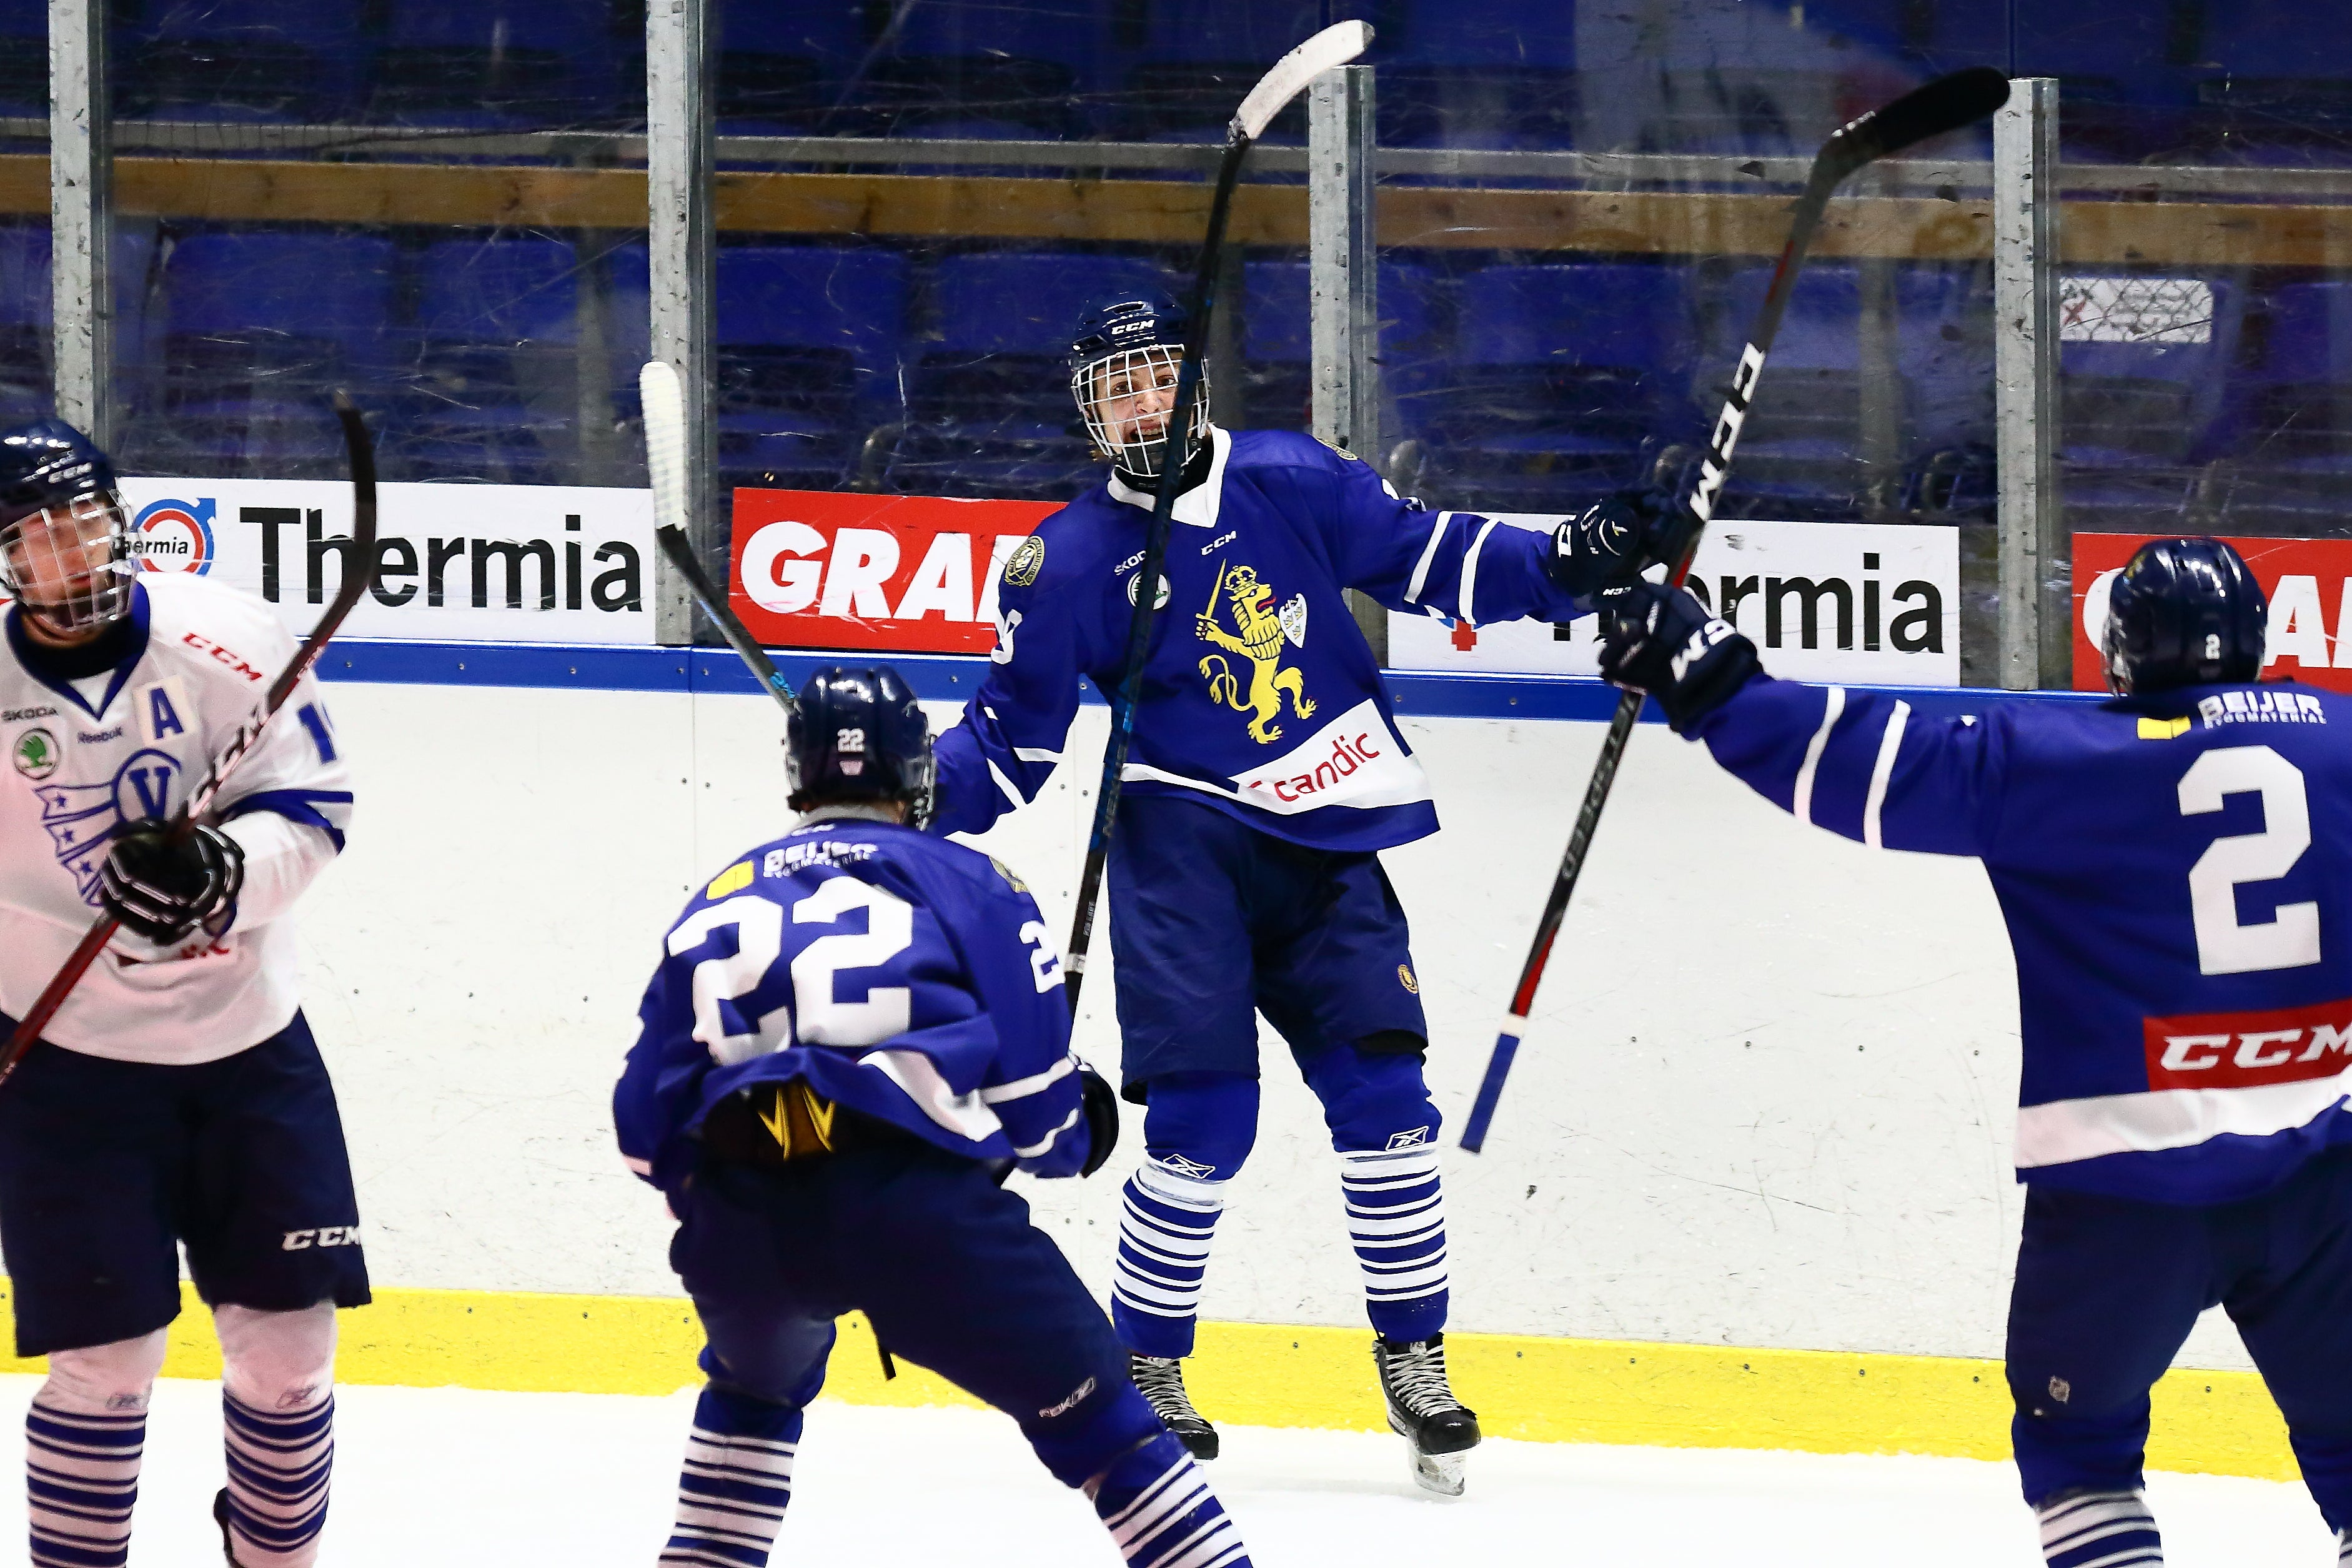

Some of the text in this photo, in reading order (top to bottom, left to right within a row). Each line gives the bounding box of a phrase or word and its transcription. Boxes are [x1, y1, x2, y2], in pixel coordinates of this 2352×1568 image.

[1111, 319, 1155, 335] CCM
[1690, 342, 1767, 522] CCM
[240, 507, 643, 613] Thermia
[1201, 530, 1236, 555] CCM
[183, 632, 262, 682] CCM
[2205, 633, 2221, 660] 2
[150, 687, 184, 740] A
[2197, 690, 2324, 718] BEIJER
[297, 702, 337, 765] 1
[837, 728, 865, 752] 22
[128, 766, 171, 820] V
[1249, 732, 1381, 802] candic
[2176, 744, 2322, 976] 2
[667, 876, 913, 1067] 22
[2160, 1023, 2352, 1071] CCM
